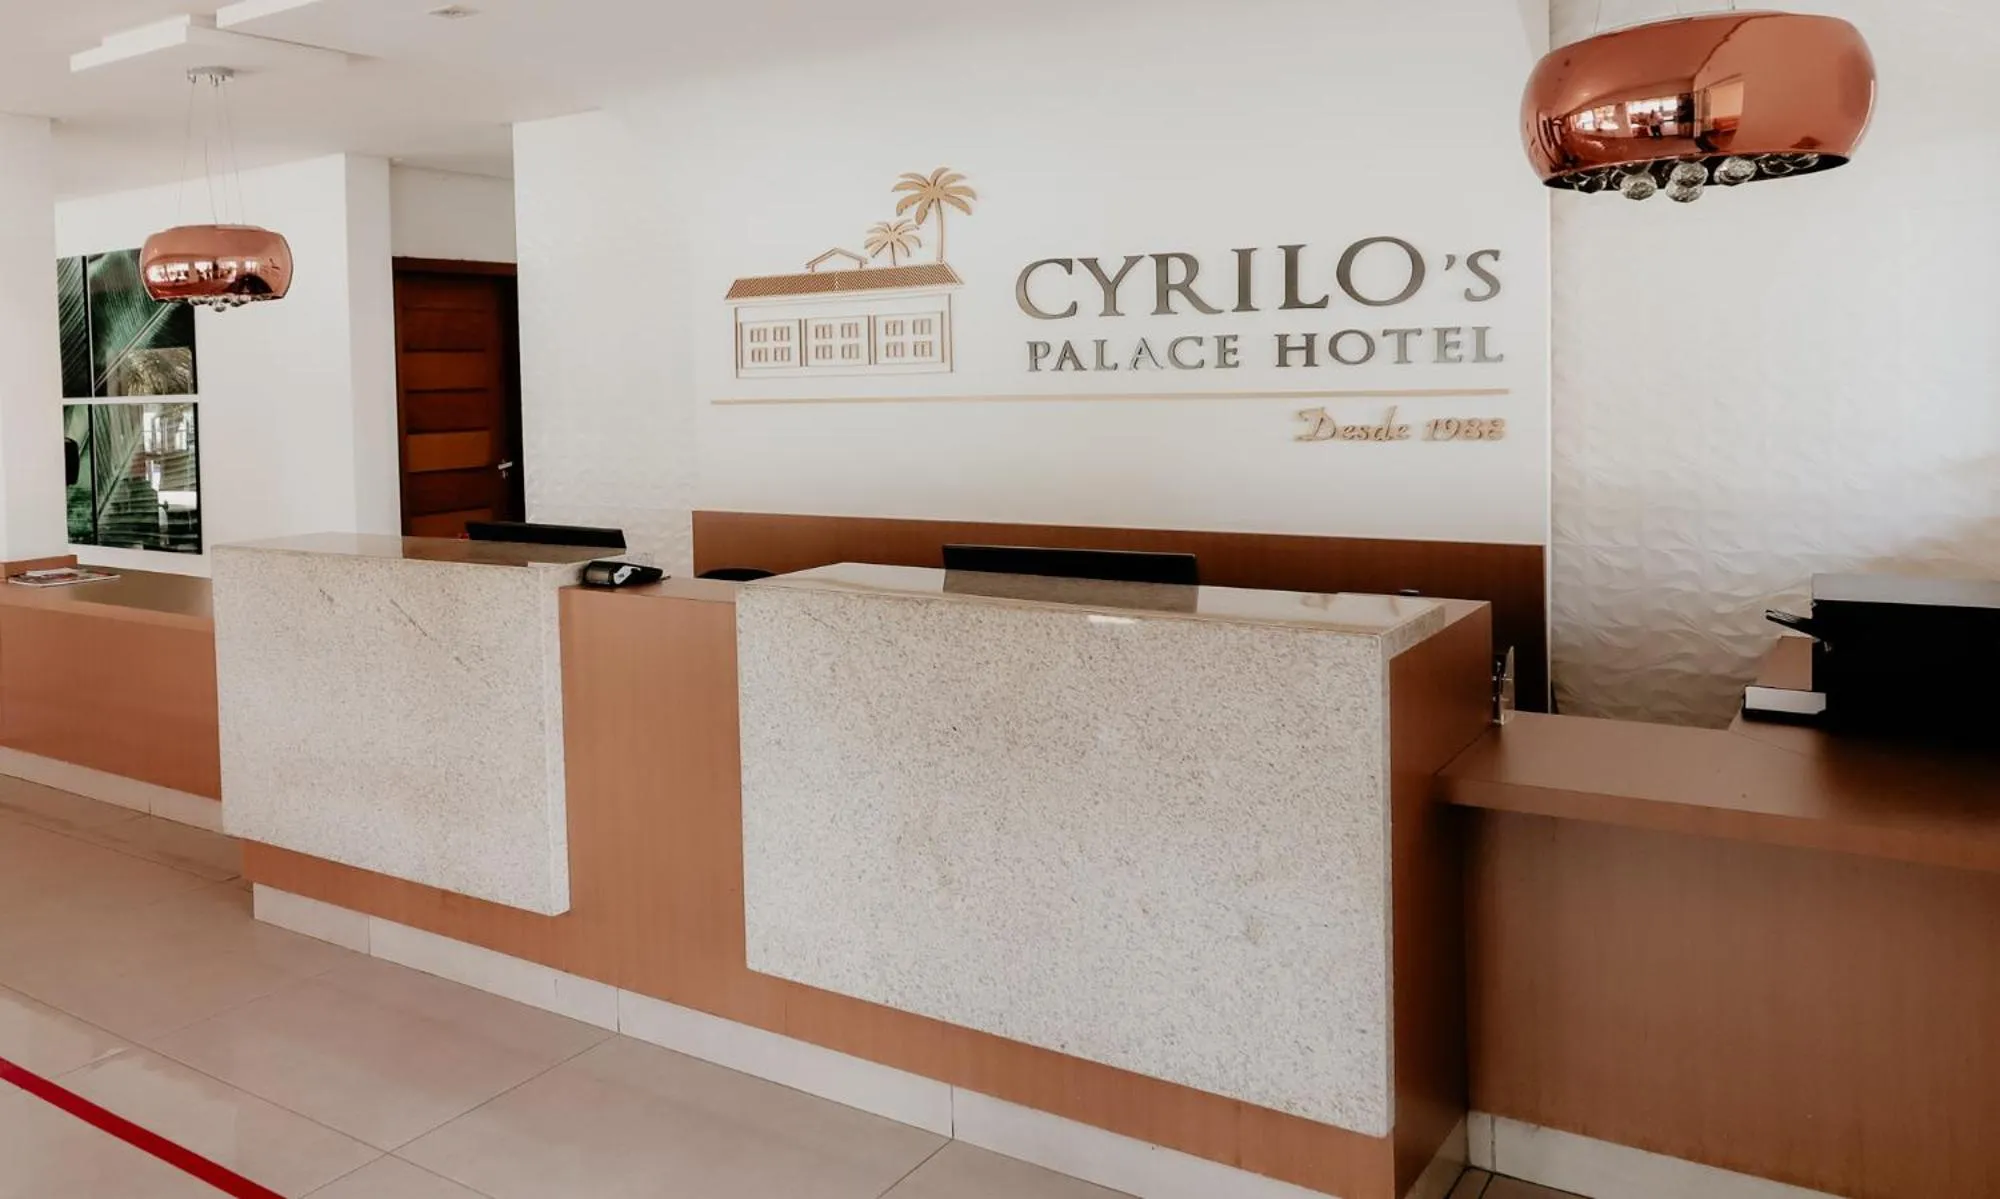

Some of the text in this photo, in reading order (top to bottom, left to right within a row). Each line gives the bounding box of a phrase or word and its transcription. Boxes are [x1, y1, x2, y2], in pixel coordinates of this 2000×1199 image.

[1026, 327, 1504, 372] PALACE HOTEL
[1294, 405, 1507, 442] Desde 1988
